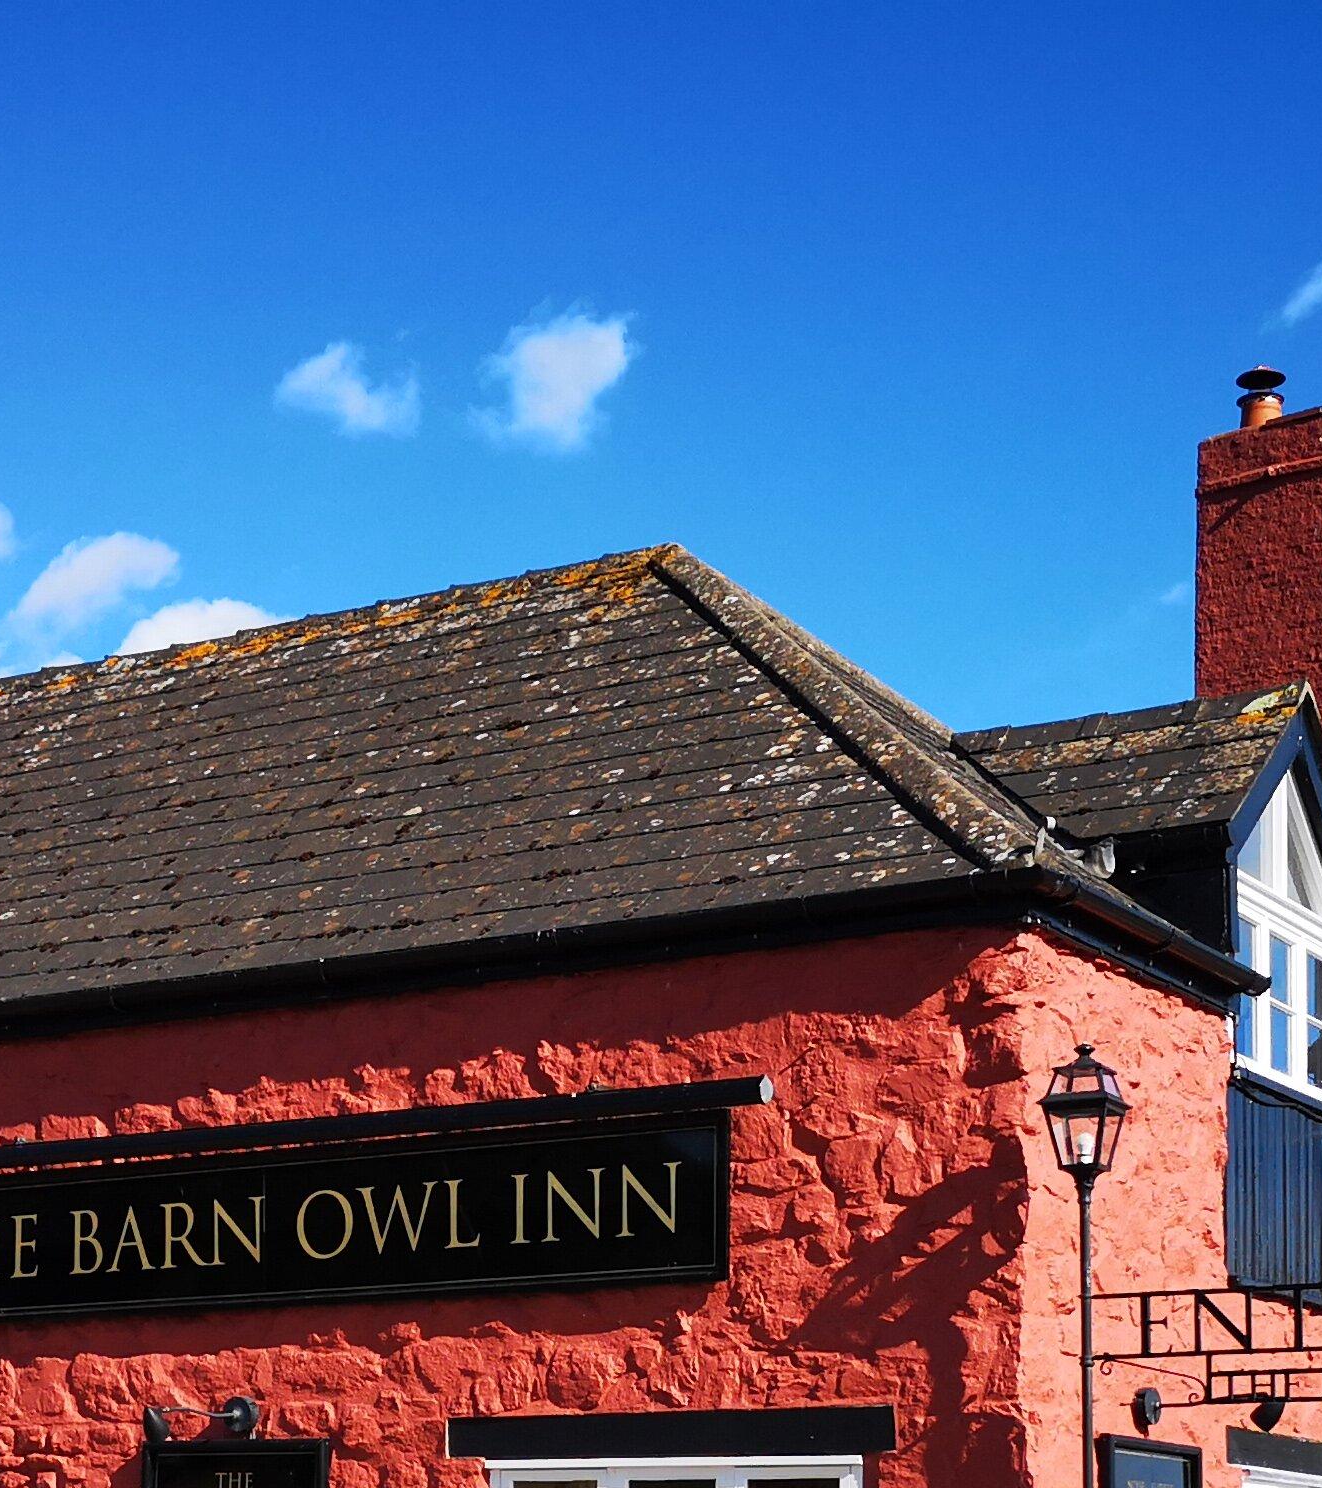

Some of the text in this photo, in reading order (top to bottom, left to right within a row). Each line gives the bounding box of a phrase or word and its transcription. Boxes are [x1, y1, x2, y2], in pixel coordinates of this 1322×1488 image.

[69, 1195, 266, 1275] BARN
[296, 1178, 481, 1260] OWL
[510, 1161, 682, 1244] INN
[1225, 1368, 1302, 1400] THE
